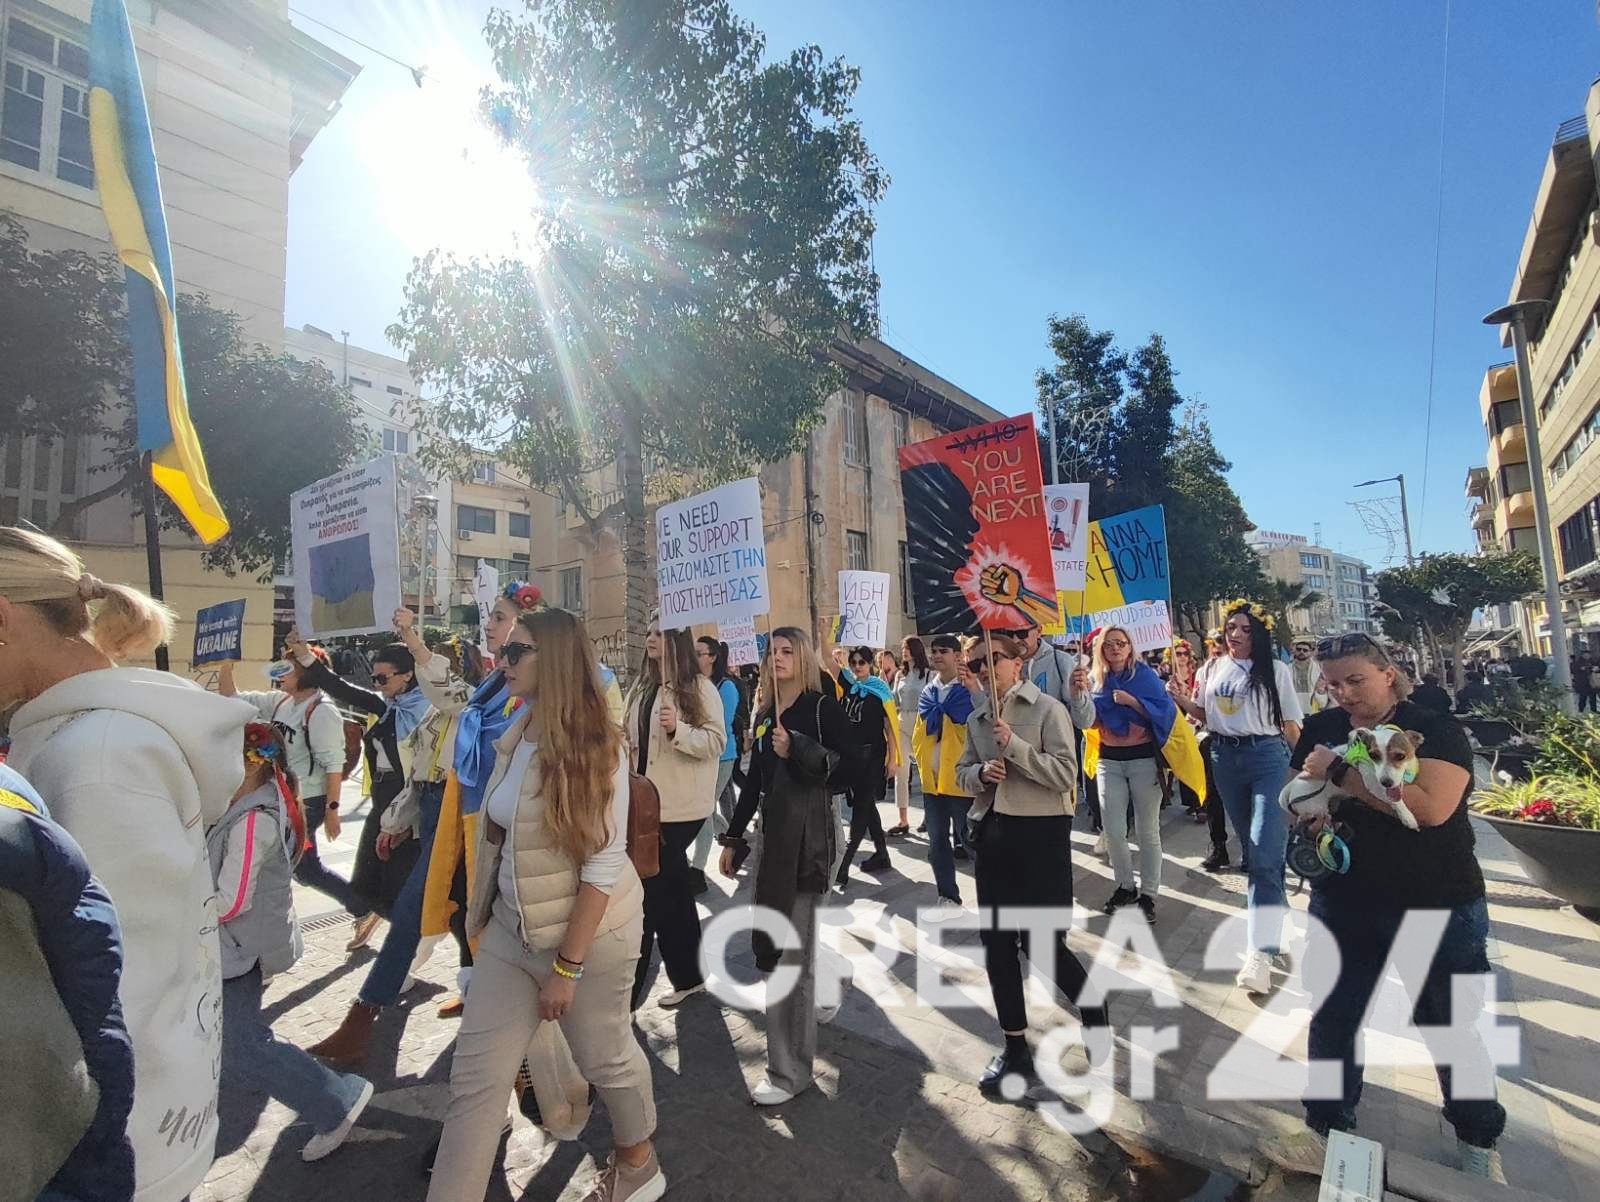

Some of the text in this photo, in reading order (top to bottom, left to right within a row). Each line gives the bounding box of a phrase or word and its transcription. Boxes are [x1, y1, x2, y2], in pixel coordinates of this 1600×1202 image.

[962, 447, 1022, 477] YOU
[972, 470, 1027, 501] ARE
[679, 501, 719, 531] NEED
[972, 493, 1042, 523] NEXT
[688, 517, 753, 554] SUPPORT
[1091, 518, 1152, 554] ANNA
[730, 547, 765, 571] ΤΗΝ
[1055, 560, 1085, 572] STATE
[1095, 540, 1166, 588] HOME
[728, 575, 762, 603] ΣΑΣ
[1092, 607, 1140, 627] PROUD
[1141, 606, 1152, 618] TO
[196, 630, 239, 656] UKRAINE
